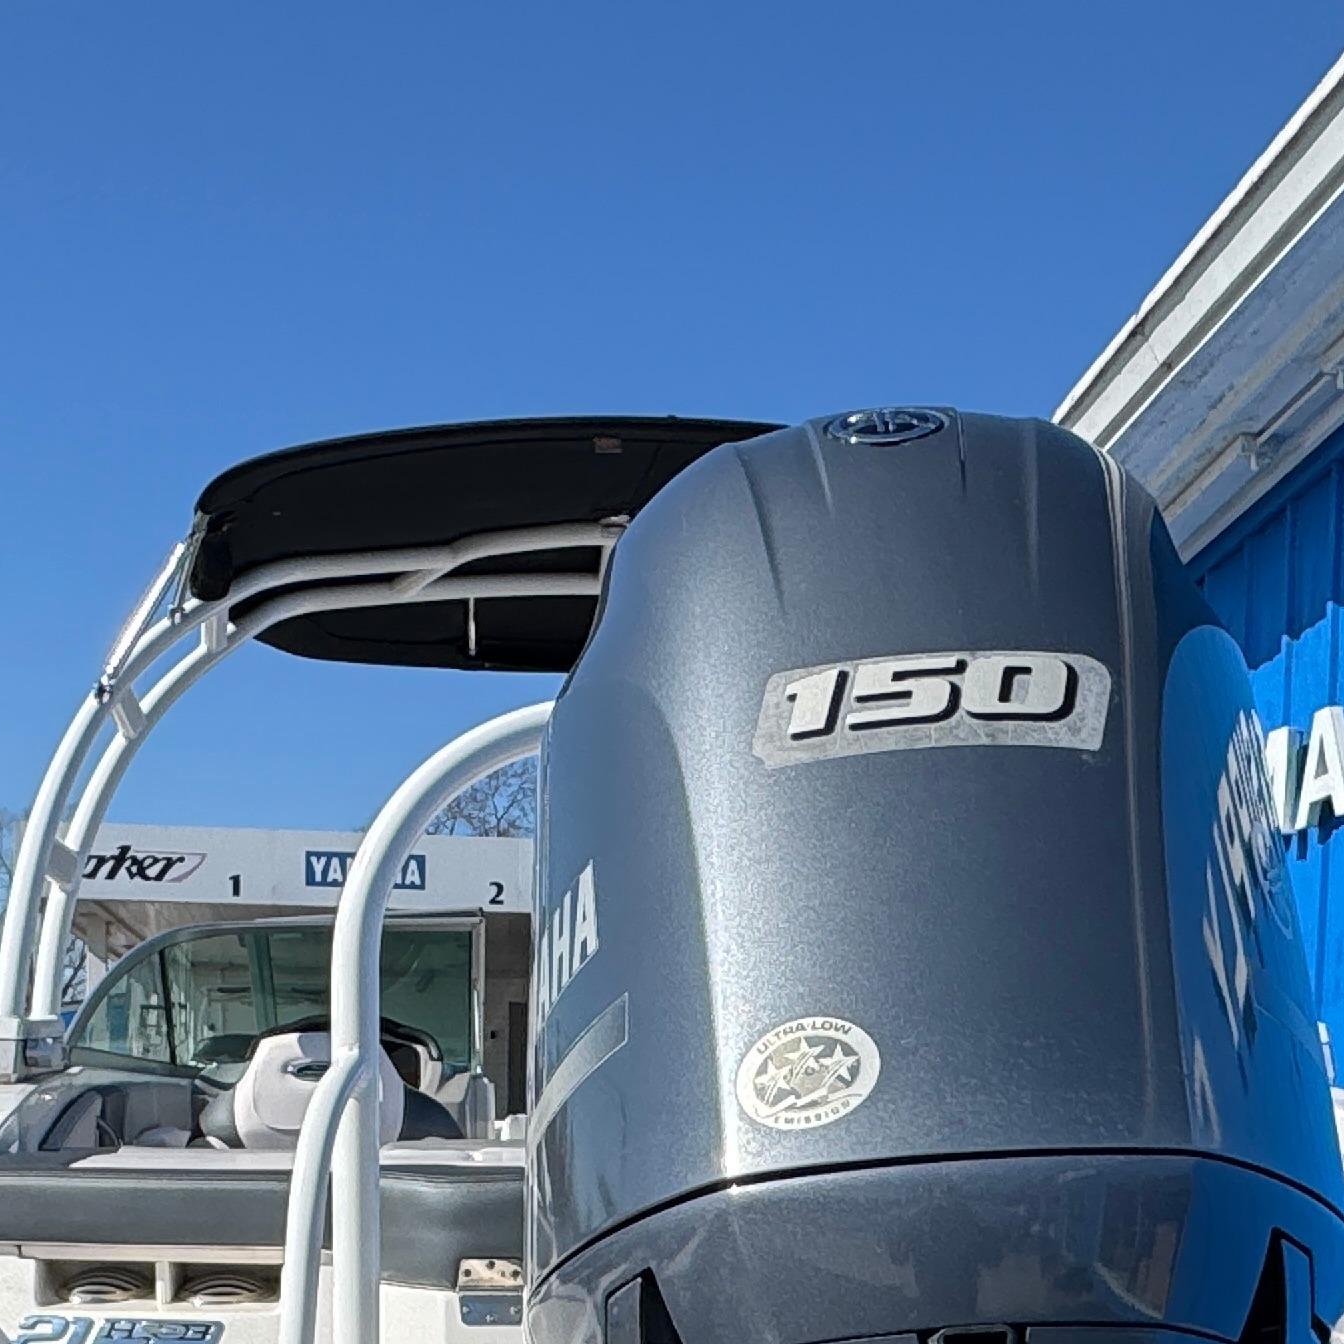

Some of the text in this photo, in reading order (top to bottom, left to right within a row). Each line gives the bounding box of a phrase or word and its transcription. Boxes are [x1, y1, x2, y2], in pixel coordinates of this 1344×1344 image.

[784, 655, 1081, 742] 150
[81, 845, 187, 882] rker
[229, 874, 242, 898] 1
[488, 881, 505, 906] 2
